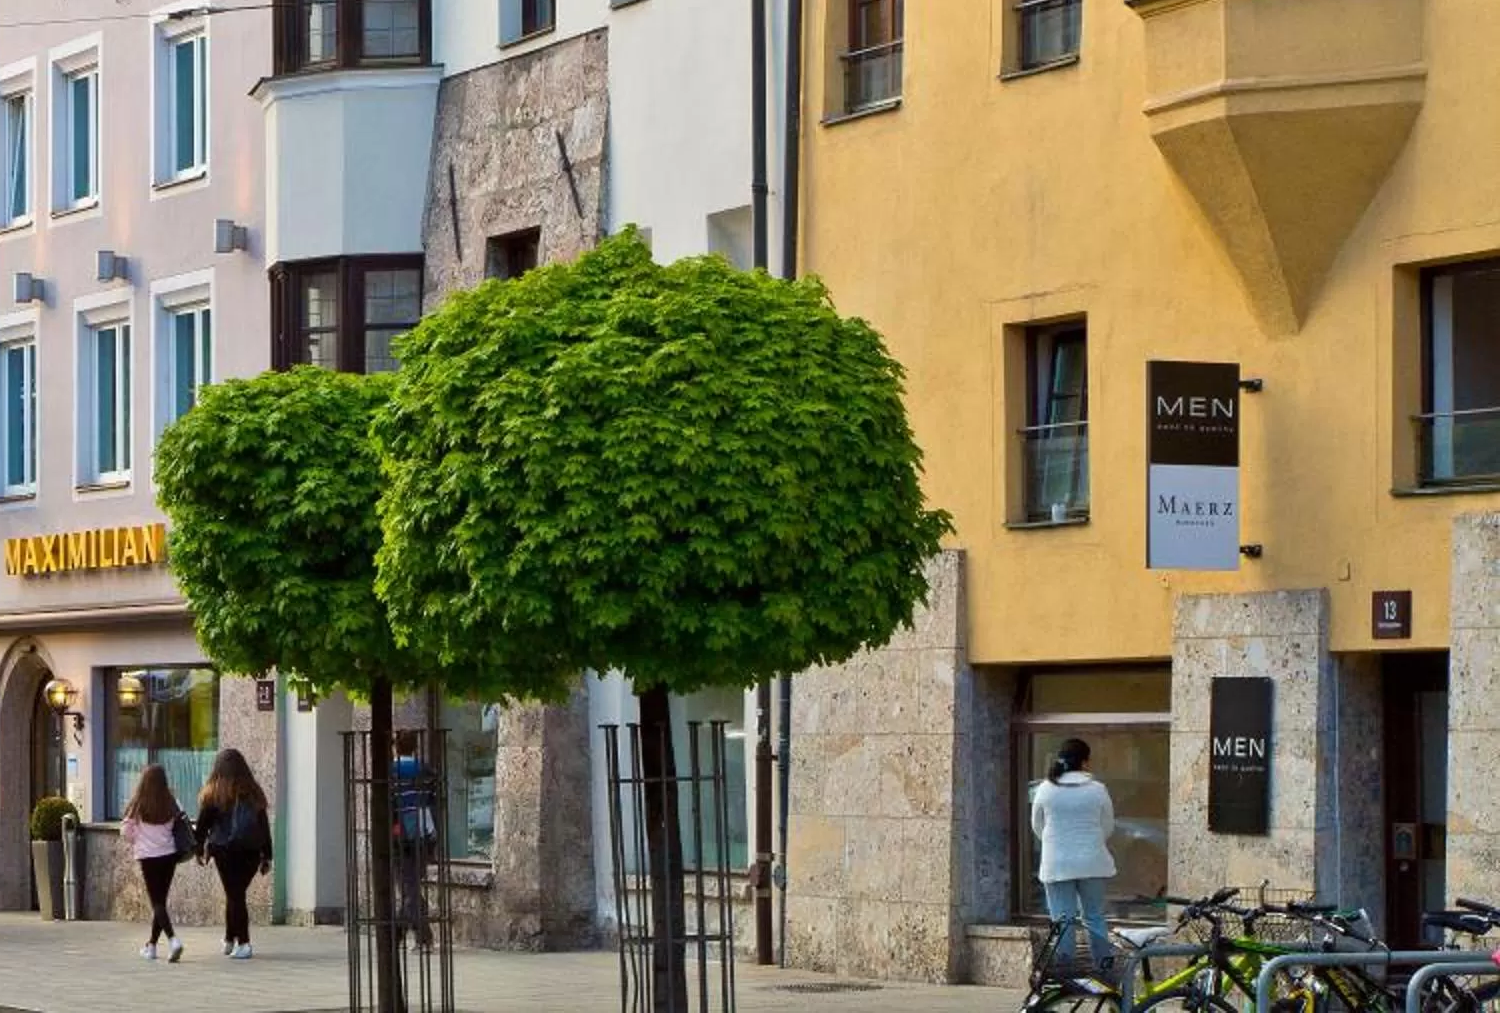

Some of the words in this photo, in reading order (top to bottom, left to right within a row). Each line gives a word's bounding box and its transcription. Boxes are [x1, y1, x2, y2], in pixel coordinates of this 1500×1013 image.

[1157, 395, 1233, 418] MEN
[3, 522, 165, 575] MAXIMILIAN
[1383, 600, 1397, 620] 13
[1213, 736, 1265, 757] MEN
